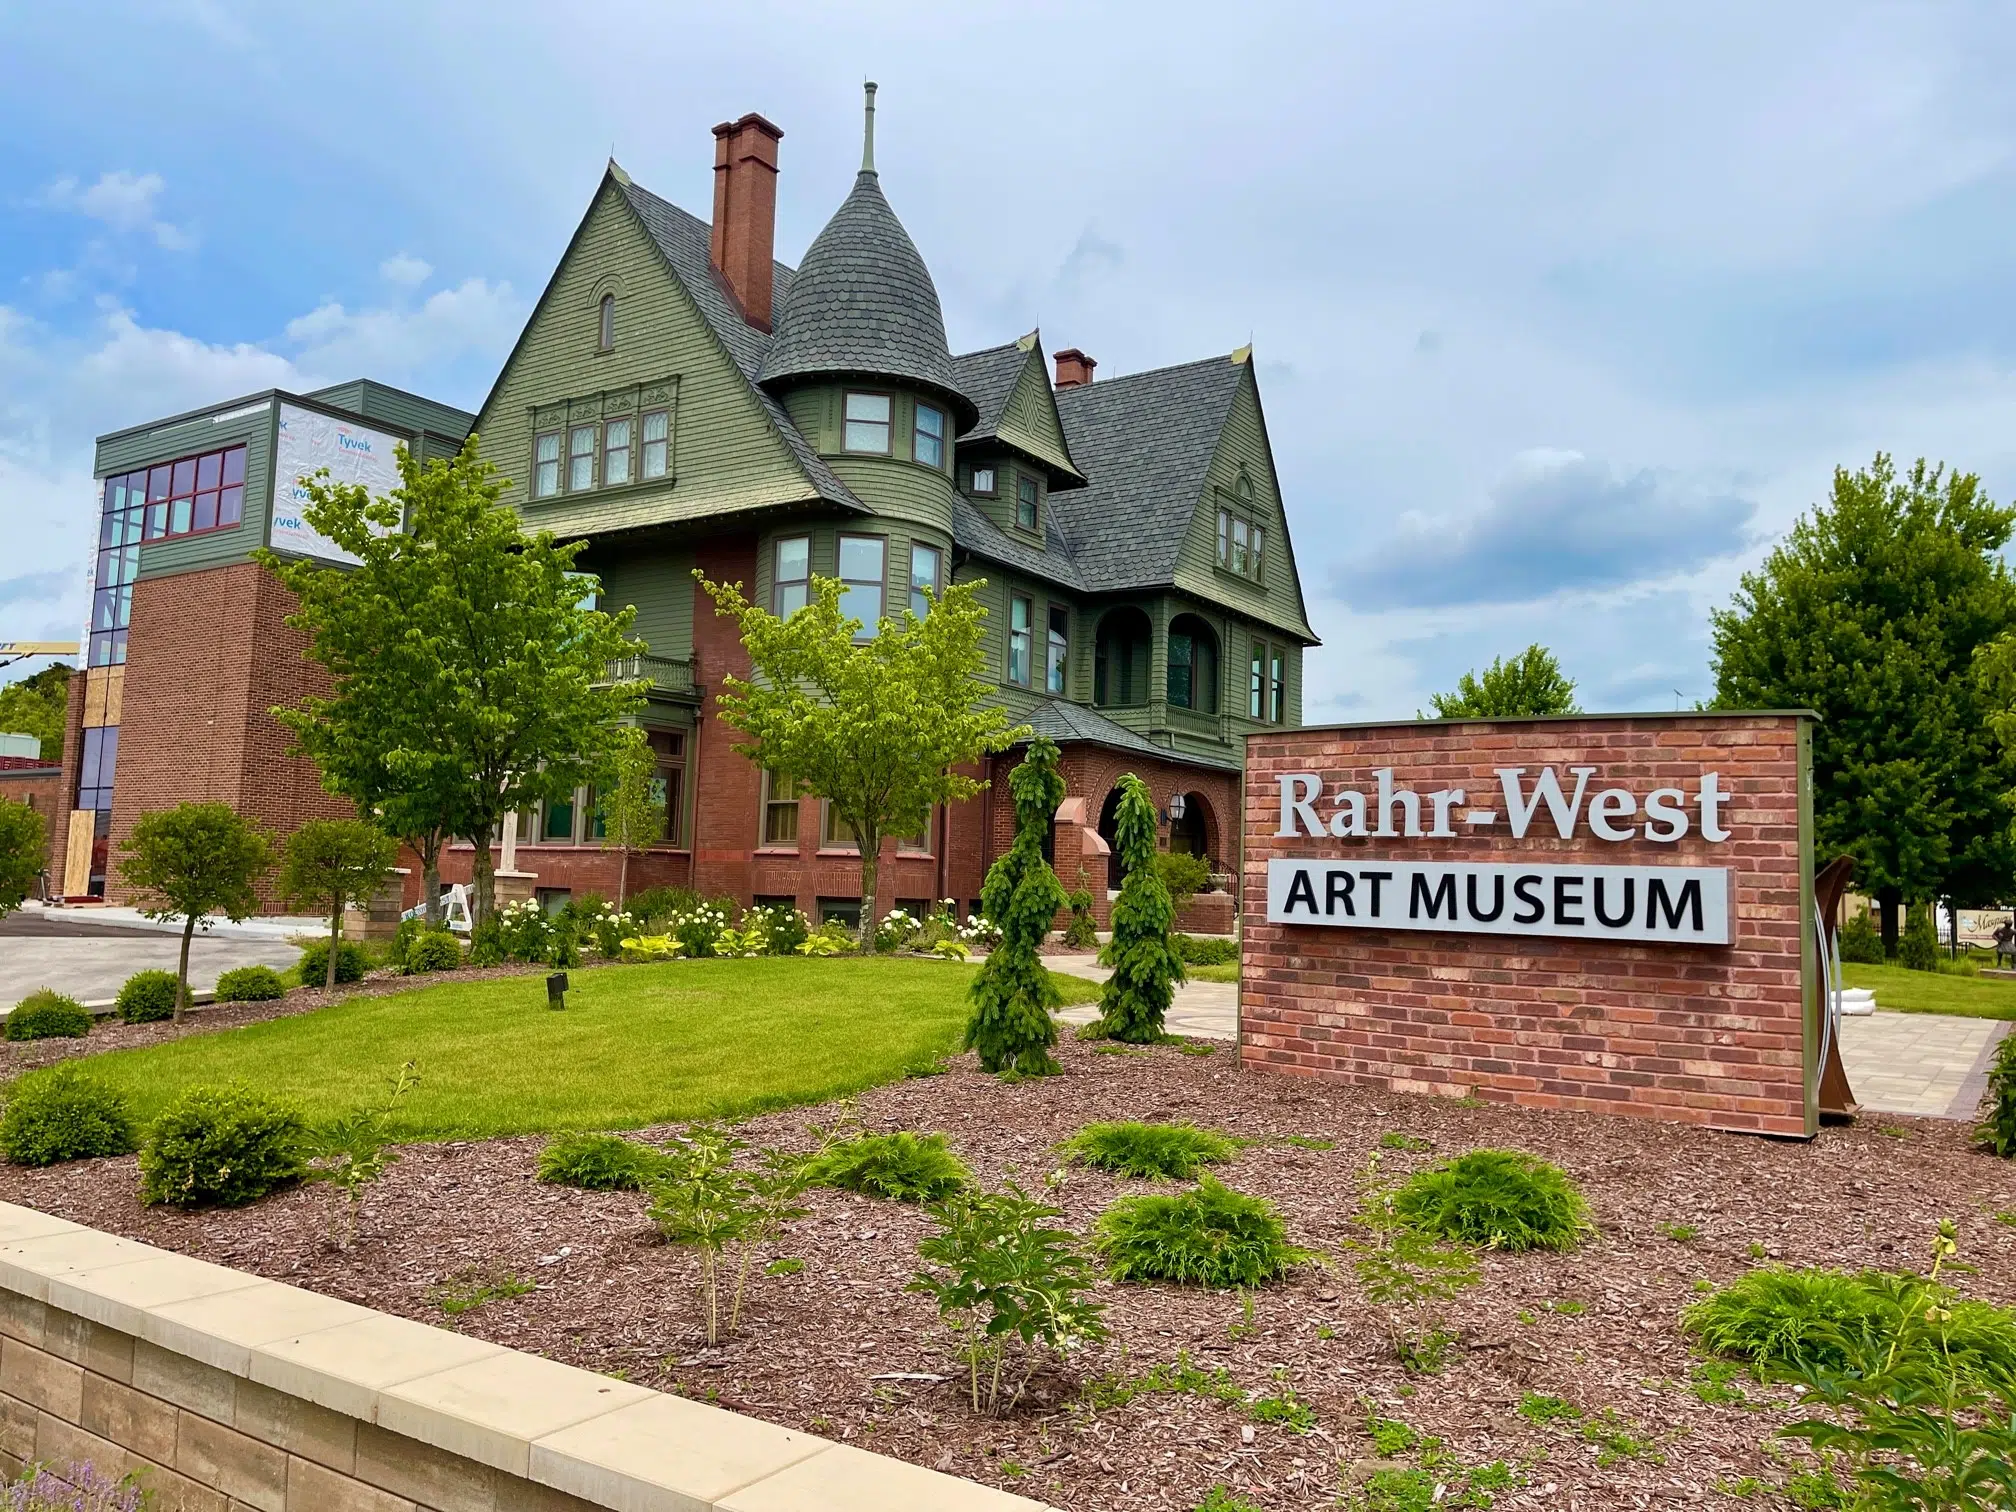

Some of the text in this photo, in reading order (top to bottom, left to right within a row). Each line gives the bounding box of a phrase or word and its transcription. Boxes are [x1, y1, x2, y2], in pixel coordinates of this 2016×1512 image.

[338, 433, 371, 452] Tyvek
[1274, 766, 1732, 843] Rahr-West
[1283, 869, 1705, 932] ART MUSEUM
